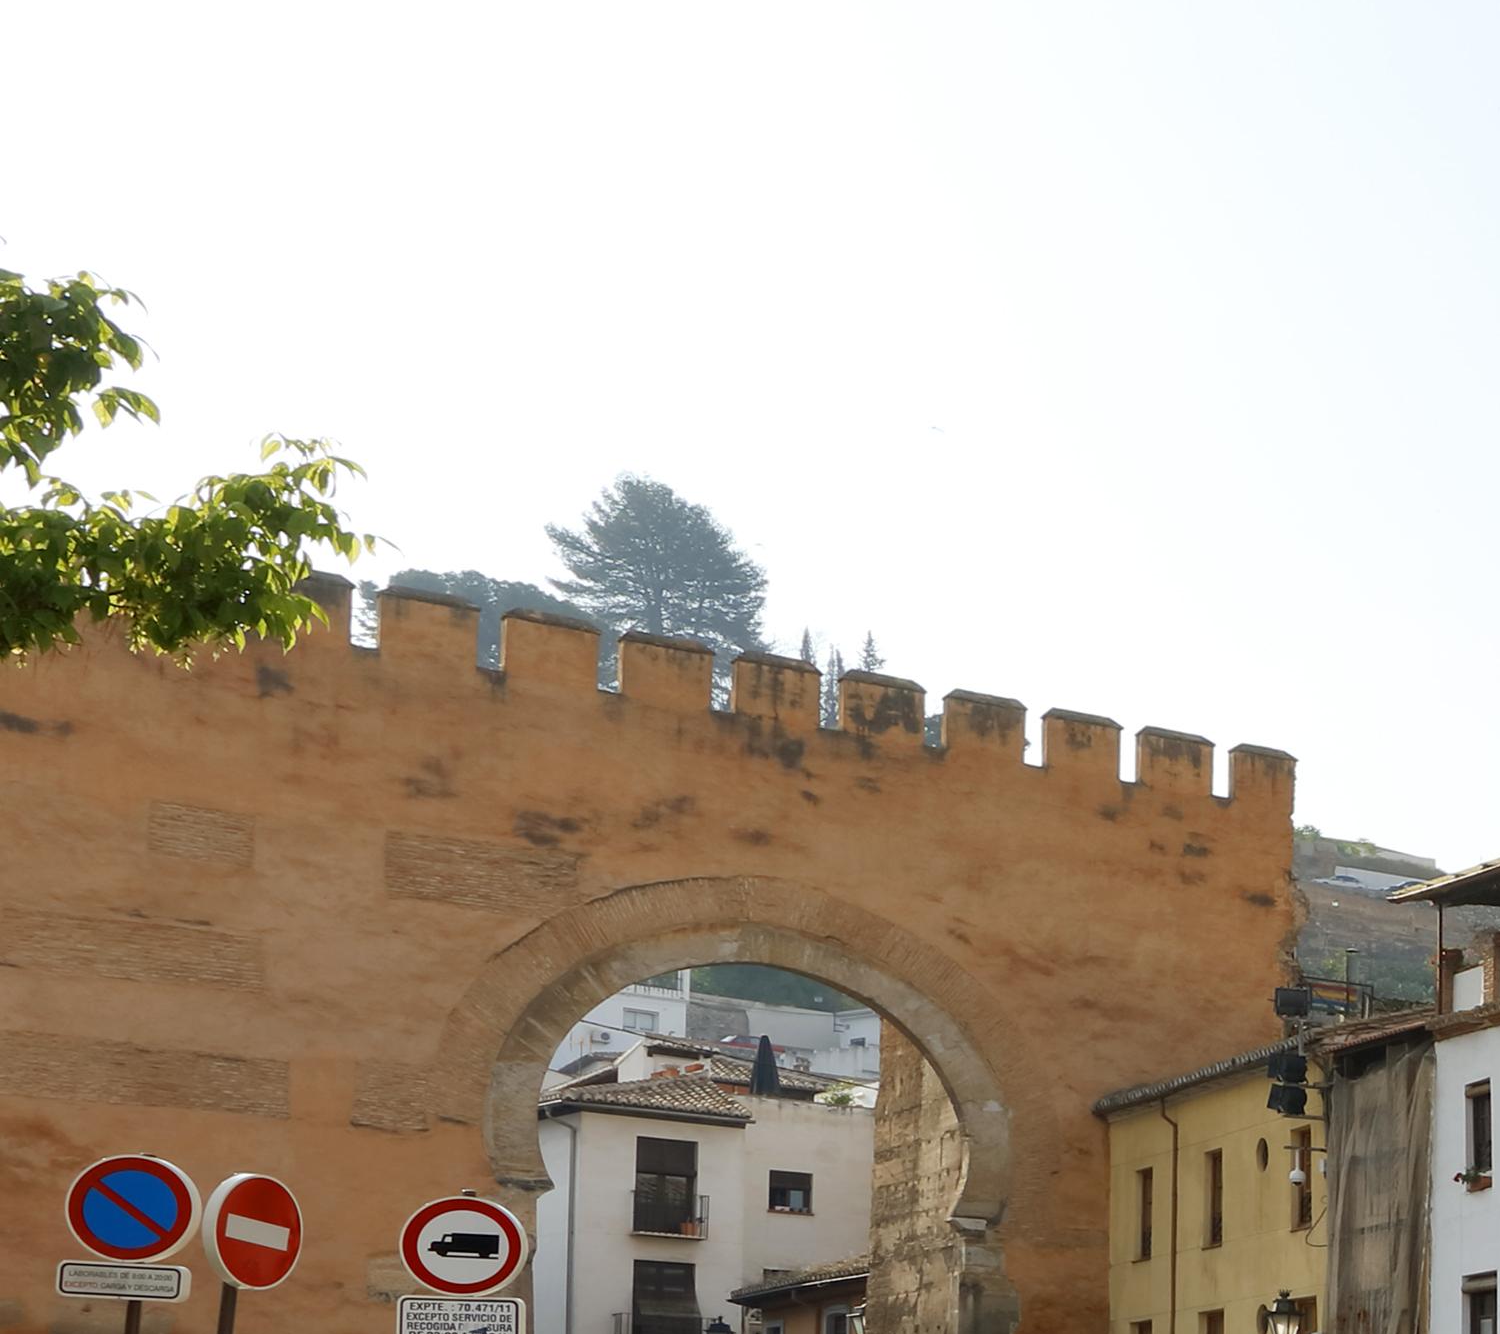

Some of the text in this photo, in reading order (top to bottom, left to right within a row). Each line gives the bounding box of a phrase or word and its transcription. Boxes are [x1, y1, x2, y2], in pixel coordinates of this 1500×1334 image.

[456, 1303, 511, 1312] 70.471/11
[406, 1312, 513, 1323] EXCEPTO SERVICIO DE
[406, 1322, 457, 1331] RECOGIDA
